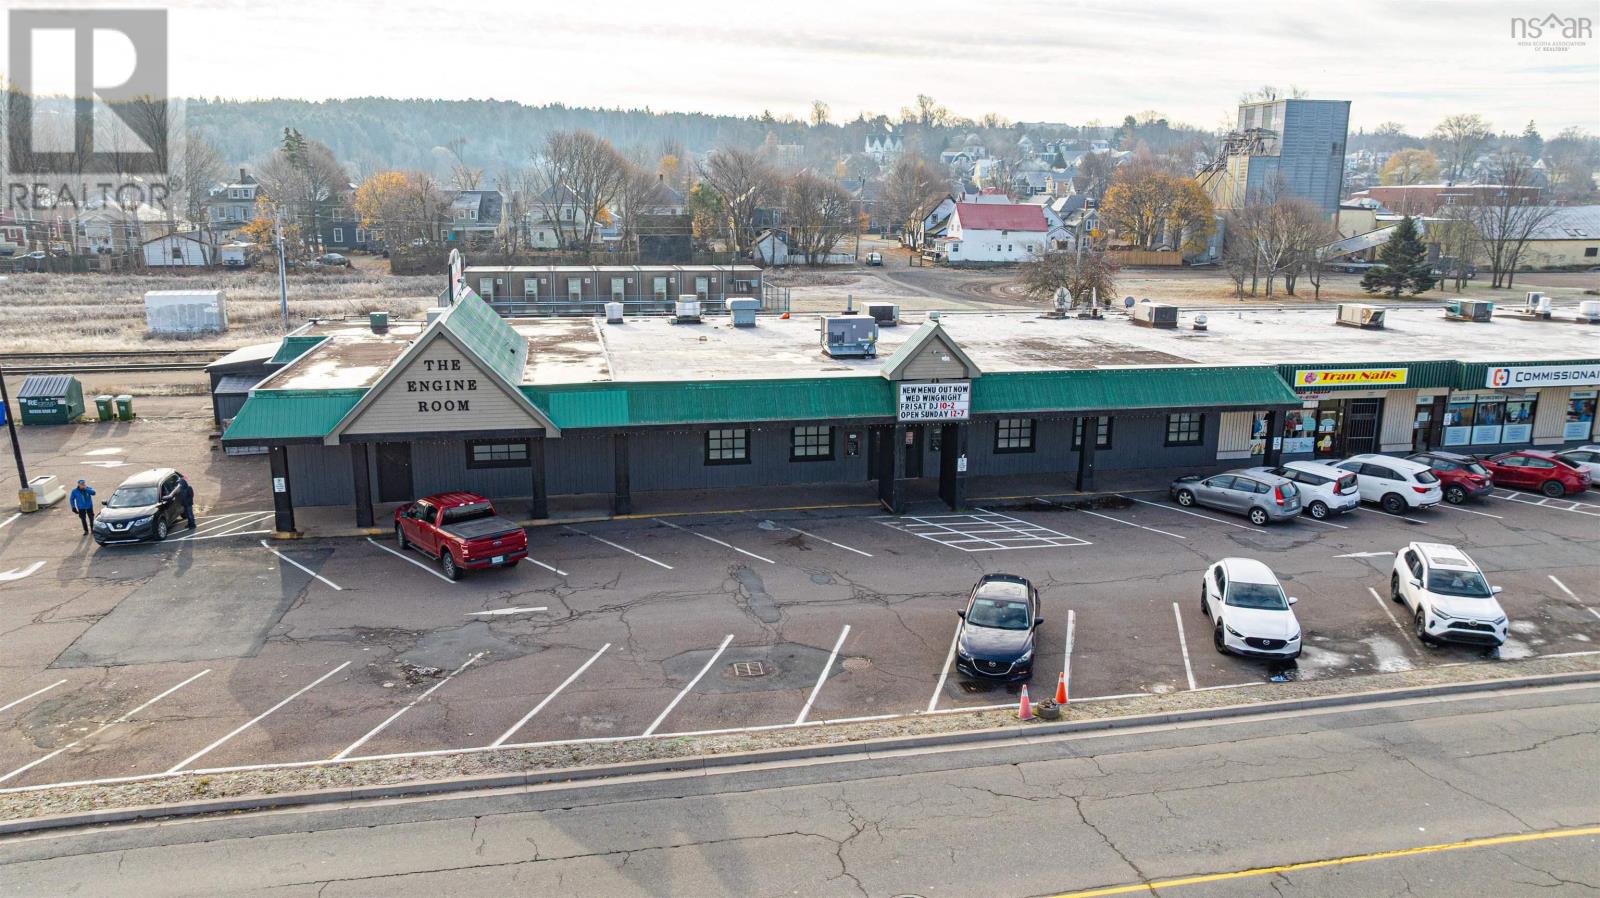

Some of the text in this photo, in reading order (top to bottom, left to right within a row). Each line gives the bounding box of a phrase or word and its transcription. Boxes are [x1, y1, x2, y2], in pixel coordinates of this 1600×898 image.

[424, 360, 461, 371] THE
[1322, 370, 1398, 381] Tran Nails
[407, 380, 477, 392] ENGINE
[918, 386, 936, 394] MENU
[953, 385, 968, 393] NOW
[418, 400, 470, 412] ROOM
[921, 410, 949, 418] SUNDAY
